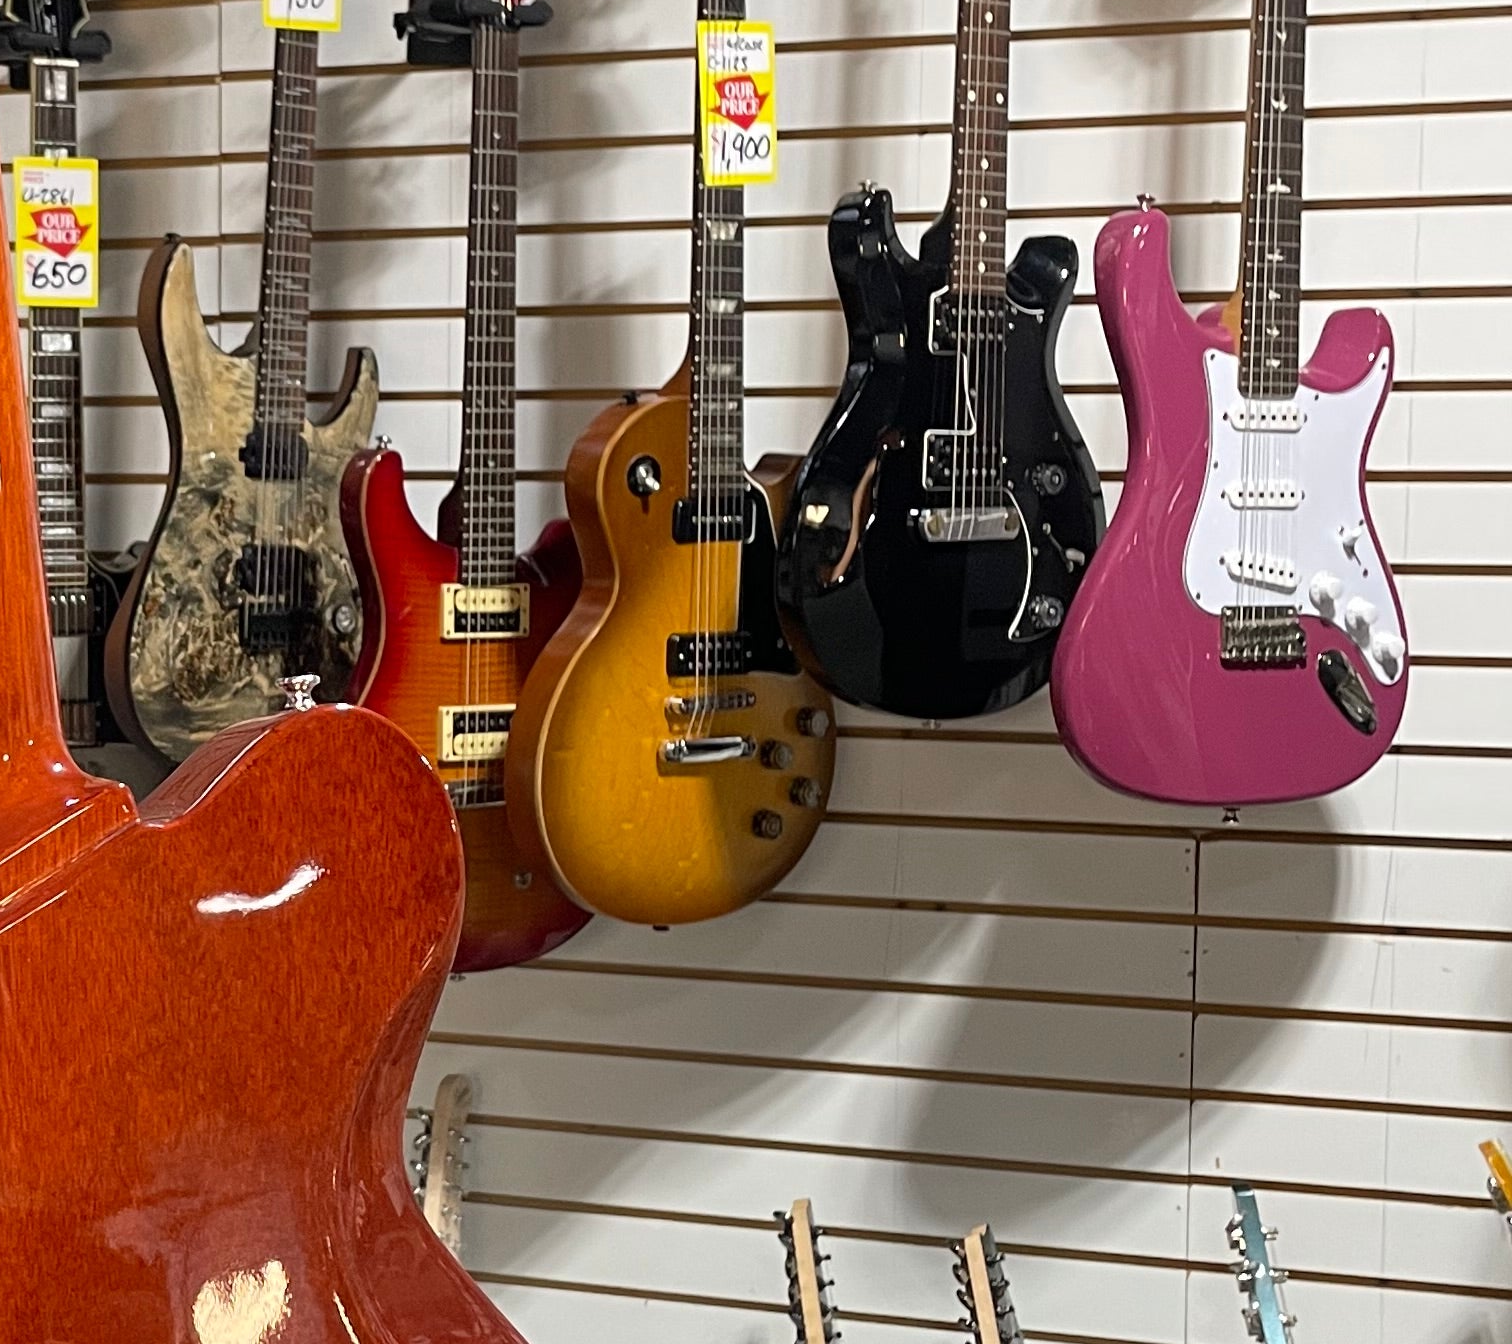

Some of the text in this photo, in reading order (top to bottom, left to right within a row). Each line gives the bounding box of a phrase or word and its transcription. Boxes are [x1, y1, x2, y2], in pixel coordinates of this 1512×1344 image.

[724, 81, 755, 98] OUR
[721, 97, 760, 116] PRICE
[41, 212, 76, 229] OUR
[38, 228, 81, 244] PRICE
